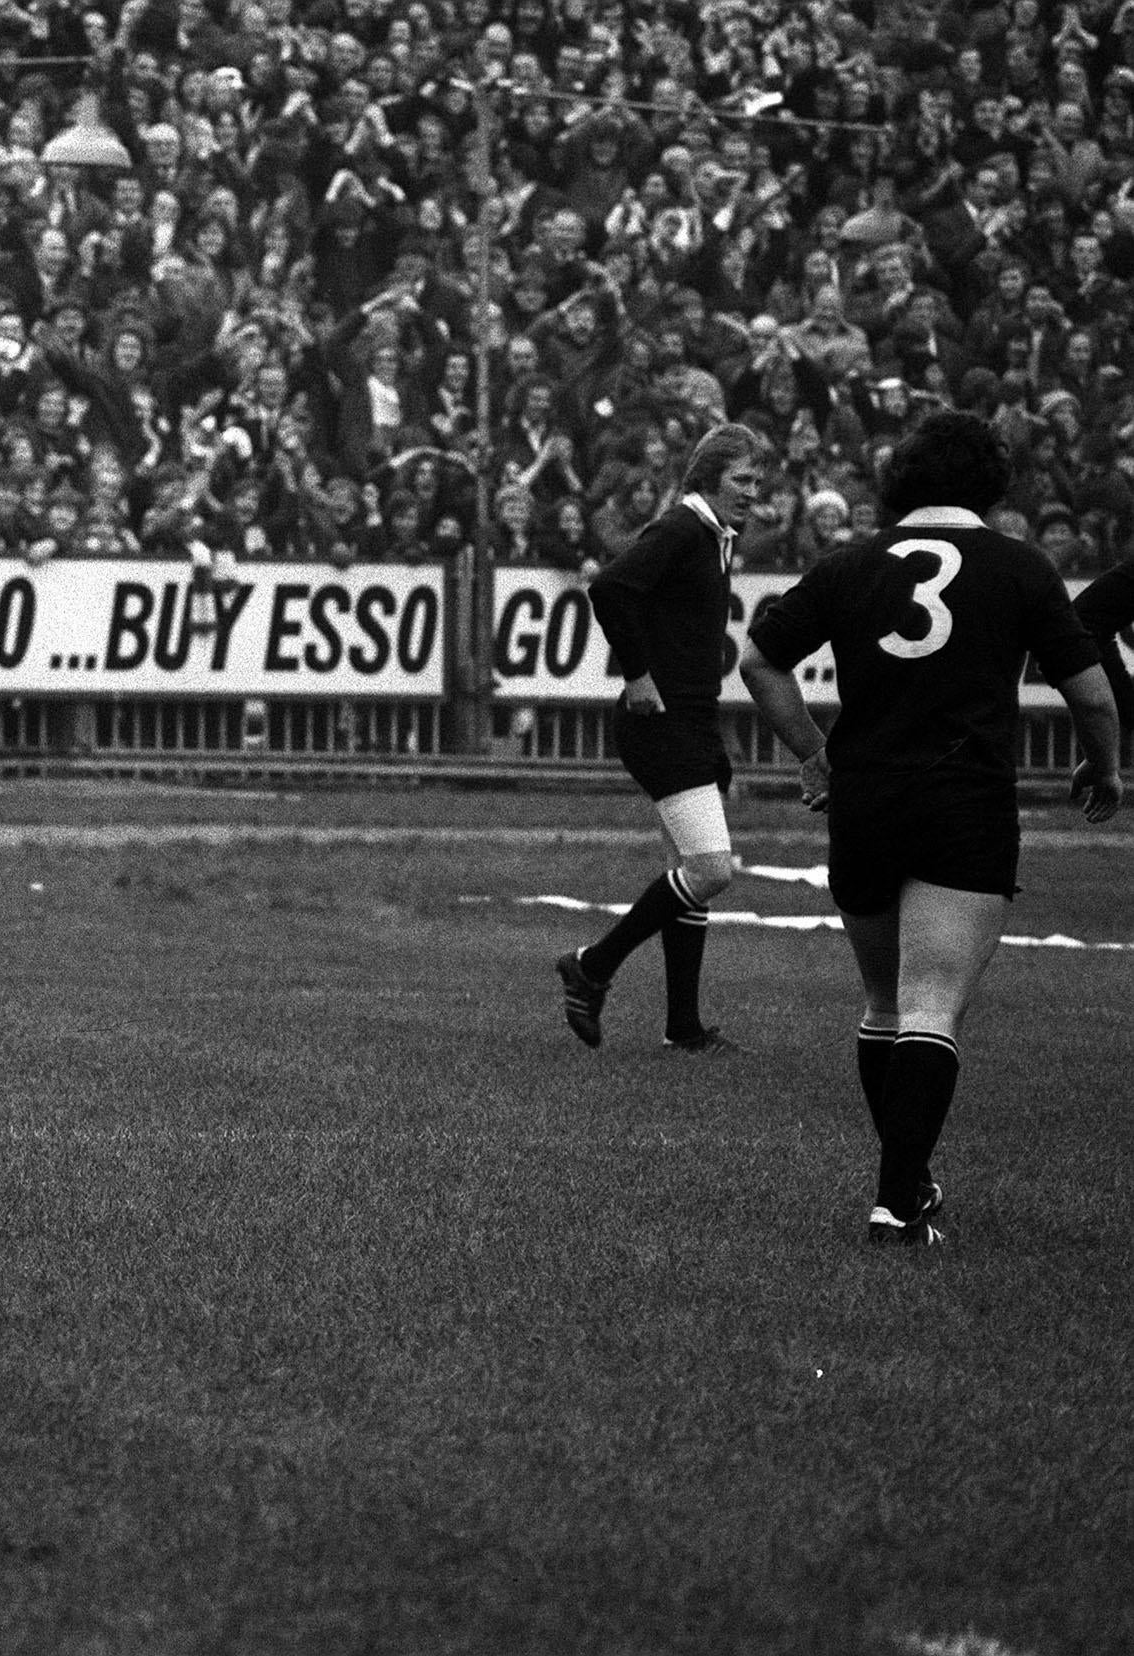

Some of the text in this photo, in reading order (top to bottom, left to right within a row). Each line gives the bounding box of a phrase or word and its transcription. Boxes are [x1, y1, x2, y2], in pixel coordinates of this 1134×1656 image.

[263, 583, 440, 676] ESSO
[493, 588, 592, 679] GO
[878, 538, 962, 658] 3
